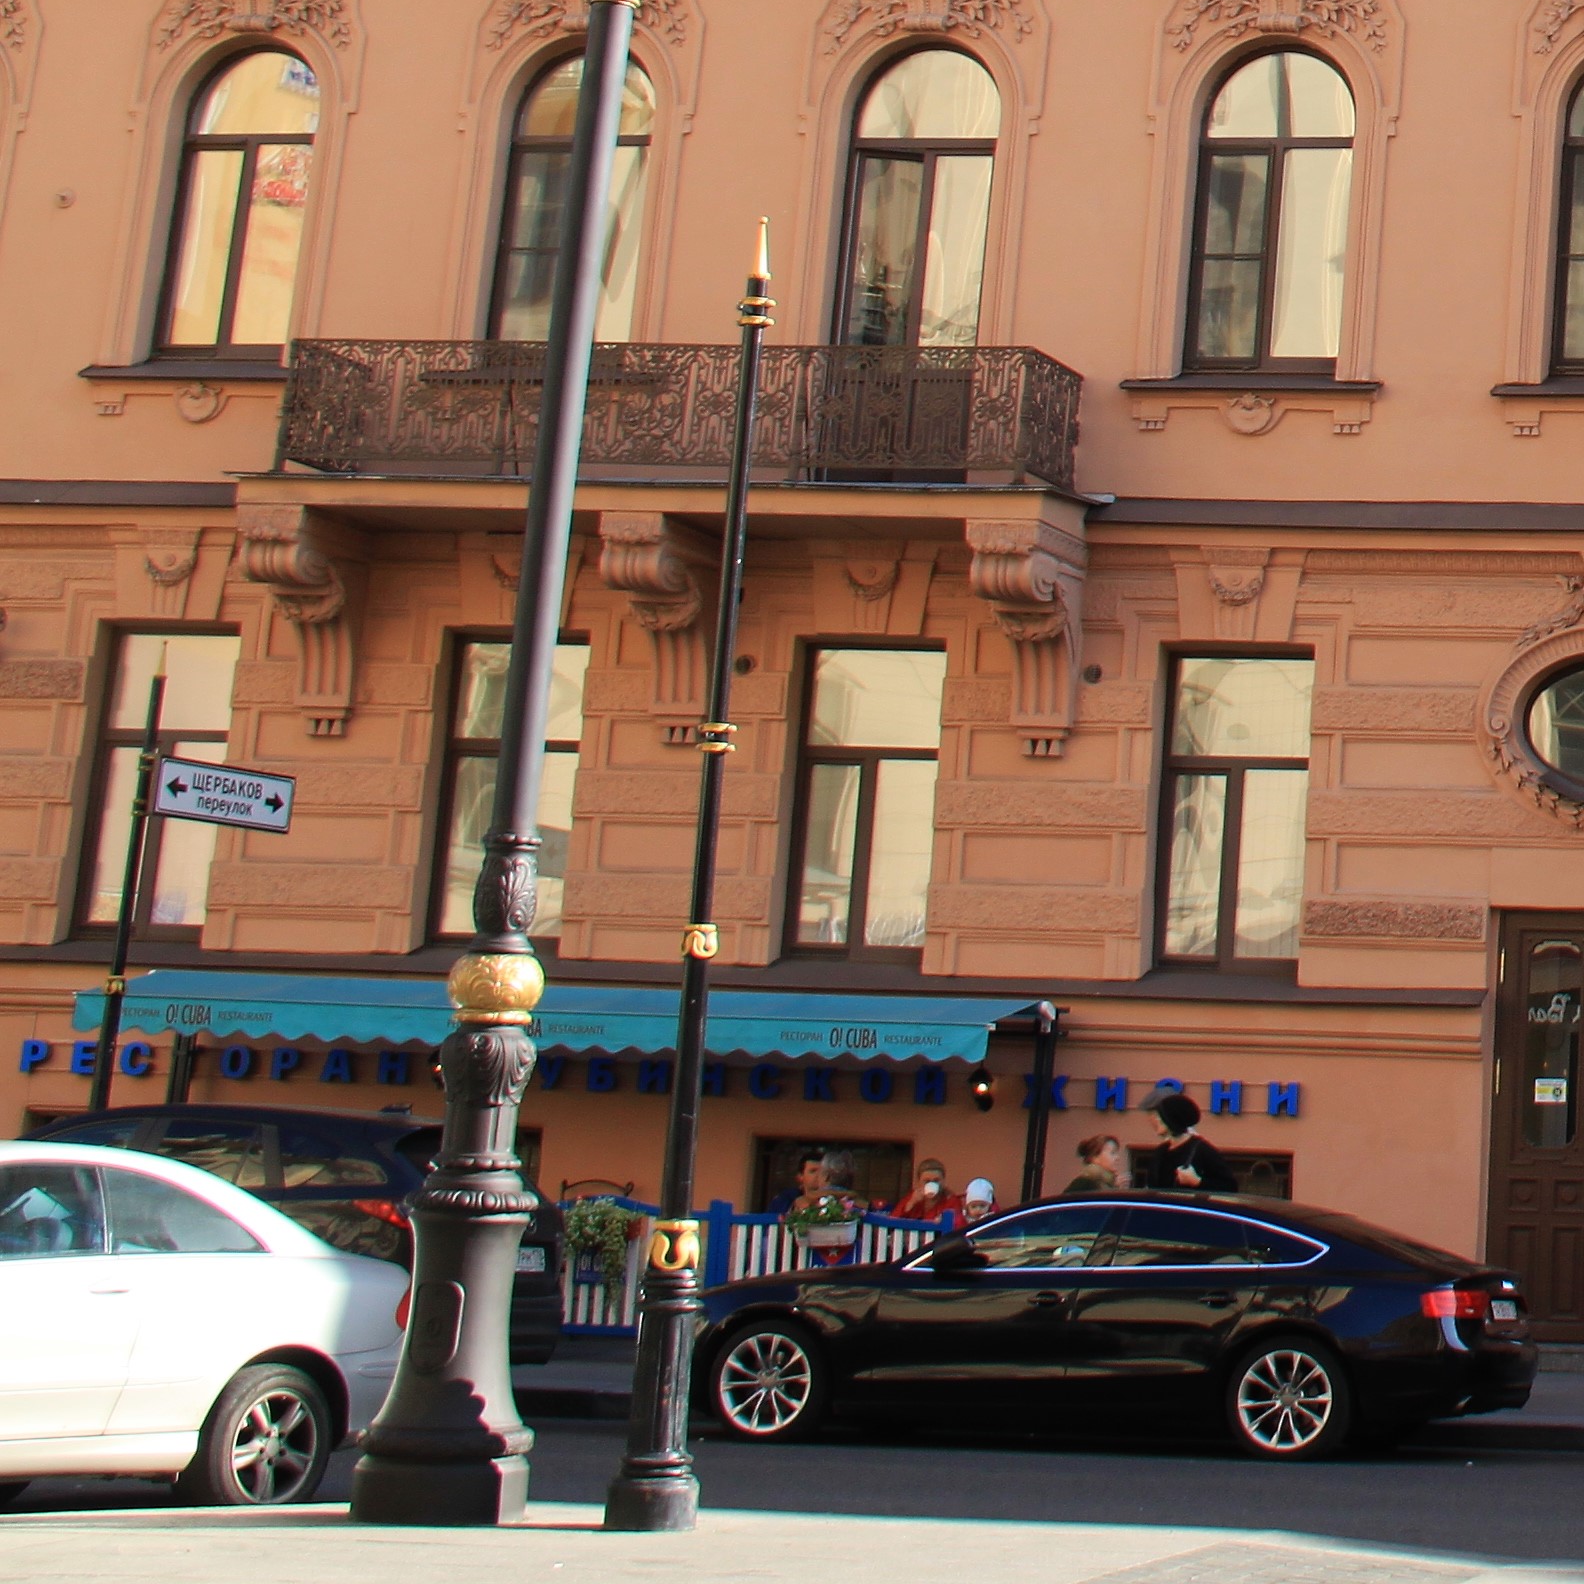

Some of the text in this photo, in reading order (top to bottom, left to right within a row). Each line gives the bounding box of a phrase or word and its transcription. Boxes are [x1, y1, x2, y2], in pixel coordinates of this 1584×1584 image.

[192, 772, 263, 800] ЩЕРБАКОВ
[197, 795, 254, 817] переулок
[181, 1004, 212, 1025] CUBA
[845, 1028, 878, 1049] CUBA
[20, 1039, 410, 1084] РЕСОРАН
[538, 1054, 946, 1105] УБИНСКОЙ
